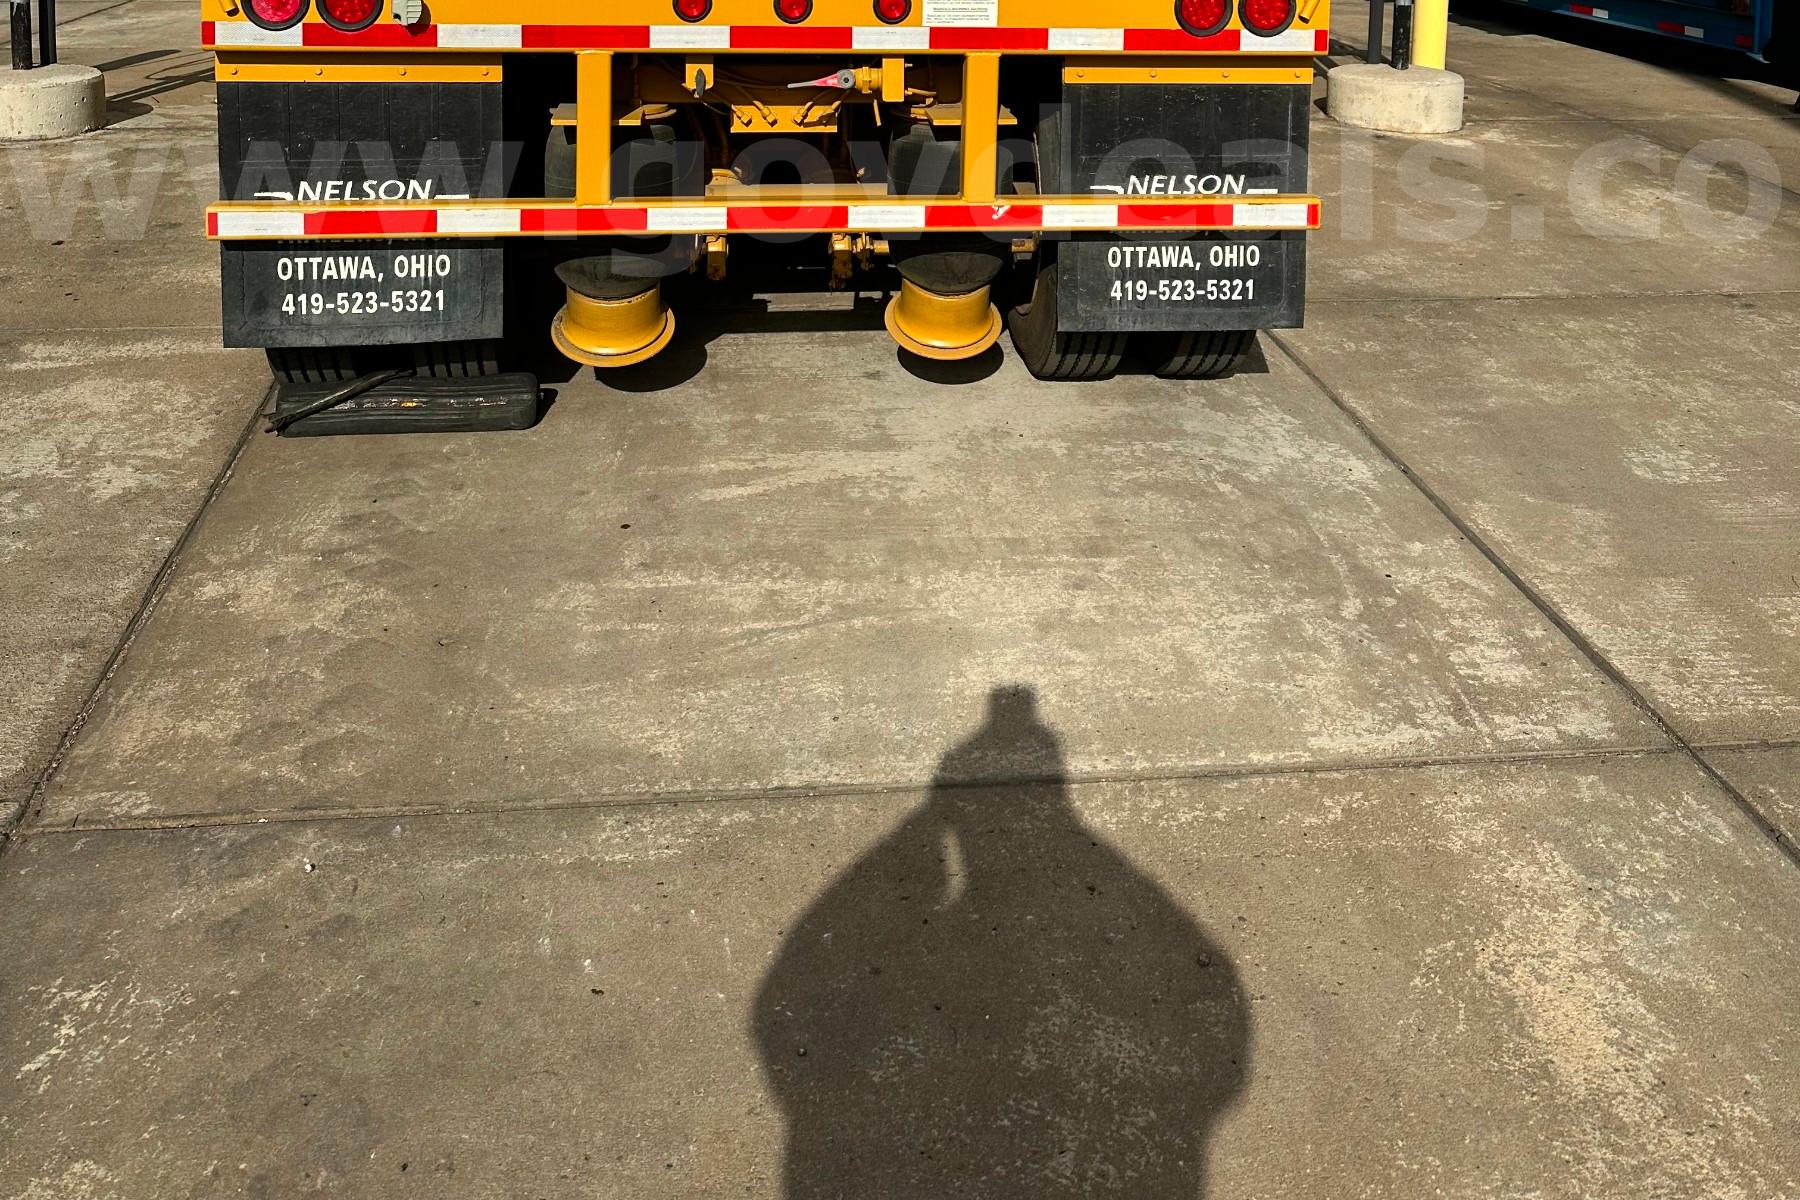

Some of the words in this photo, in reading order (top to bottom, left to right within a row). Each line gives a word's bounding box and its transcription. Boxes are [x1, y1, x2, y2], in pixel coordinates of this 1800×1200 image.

[298, 179, 432, 200] NELSON
[1127, 174, 1246, 194] NELSON
[277, 256, 384, 282] OTTAWA,
[394, 254, 451, 277] OHIO
[1107, 246, 1201, 271] OTTAWA,
[1209, 245, 1260, 267] OHIO
[281, 289, 445, 315] 419-523-5321
[1110, 279, 1255, 301] 419-523-5321
